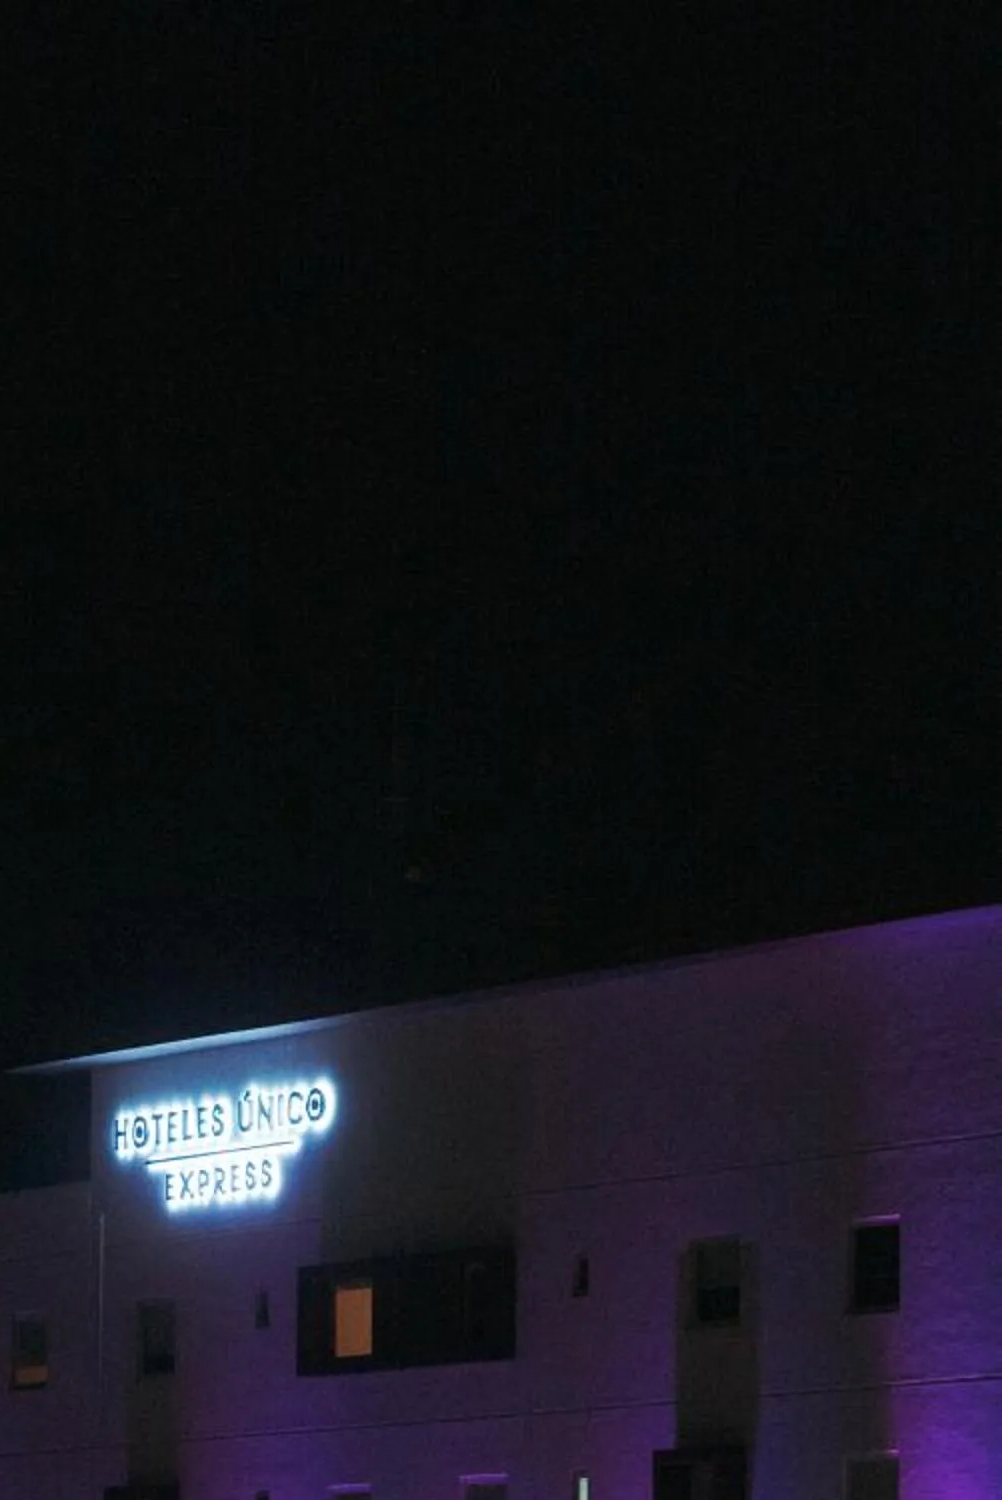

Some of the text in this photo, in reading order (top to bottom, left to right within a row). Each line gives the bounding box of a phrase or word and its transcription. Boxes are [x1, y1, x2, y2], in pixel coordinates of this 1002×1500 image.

[114, 1087, 326, 1150] HOTELES ÚNICO
[165, 1159, 273, 1201] EXPRESS
